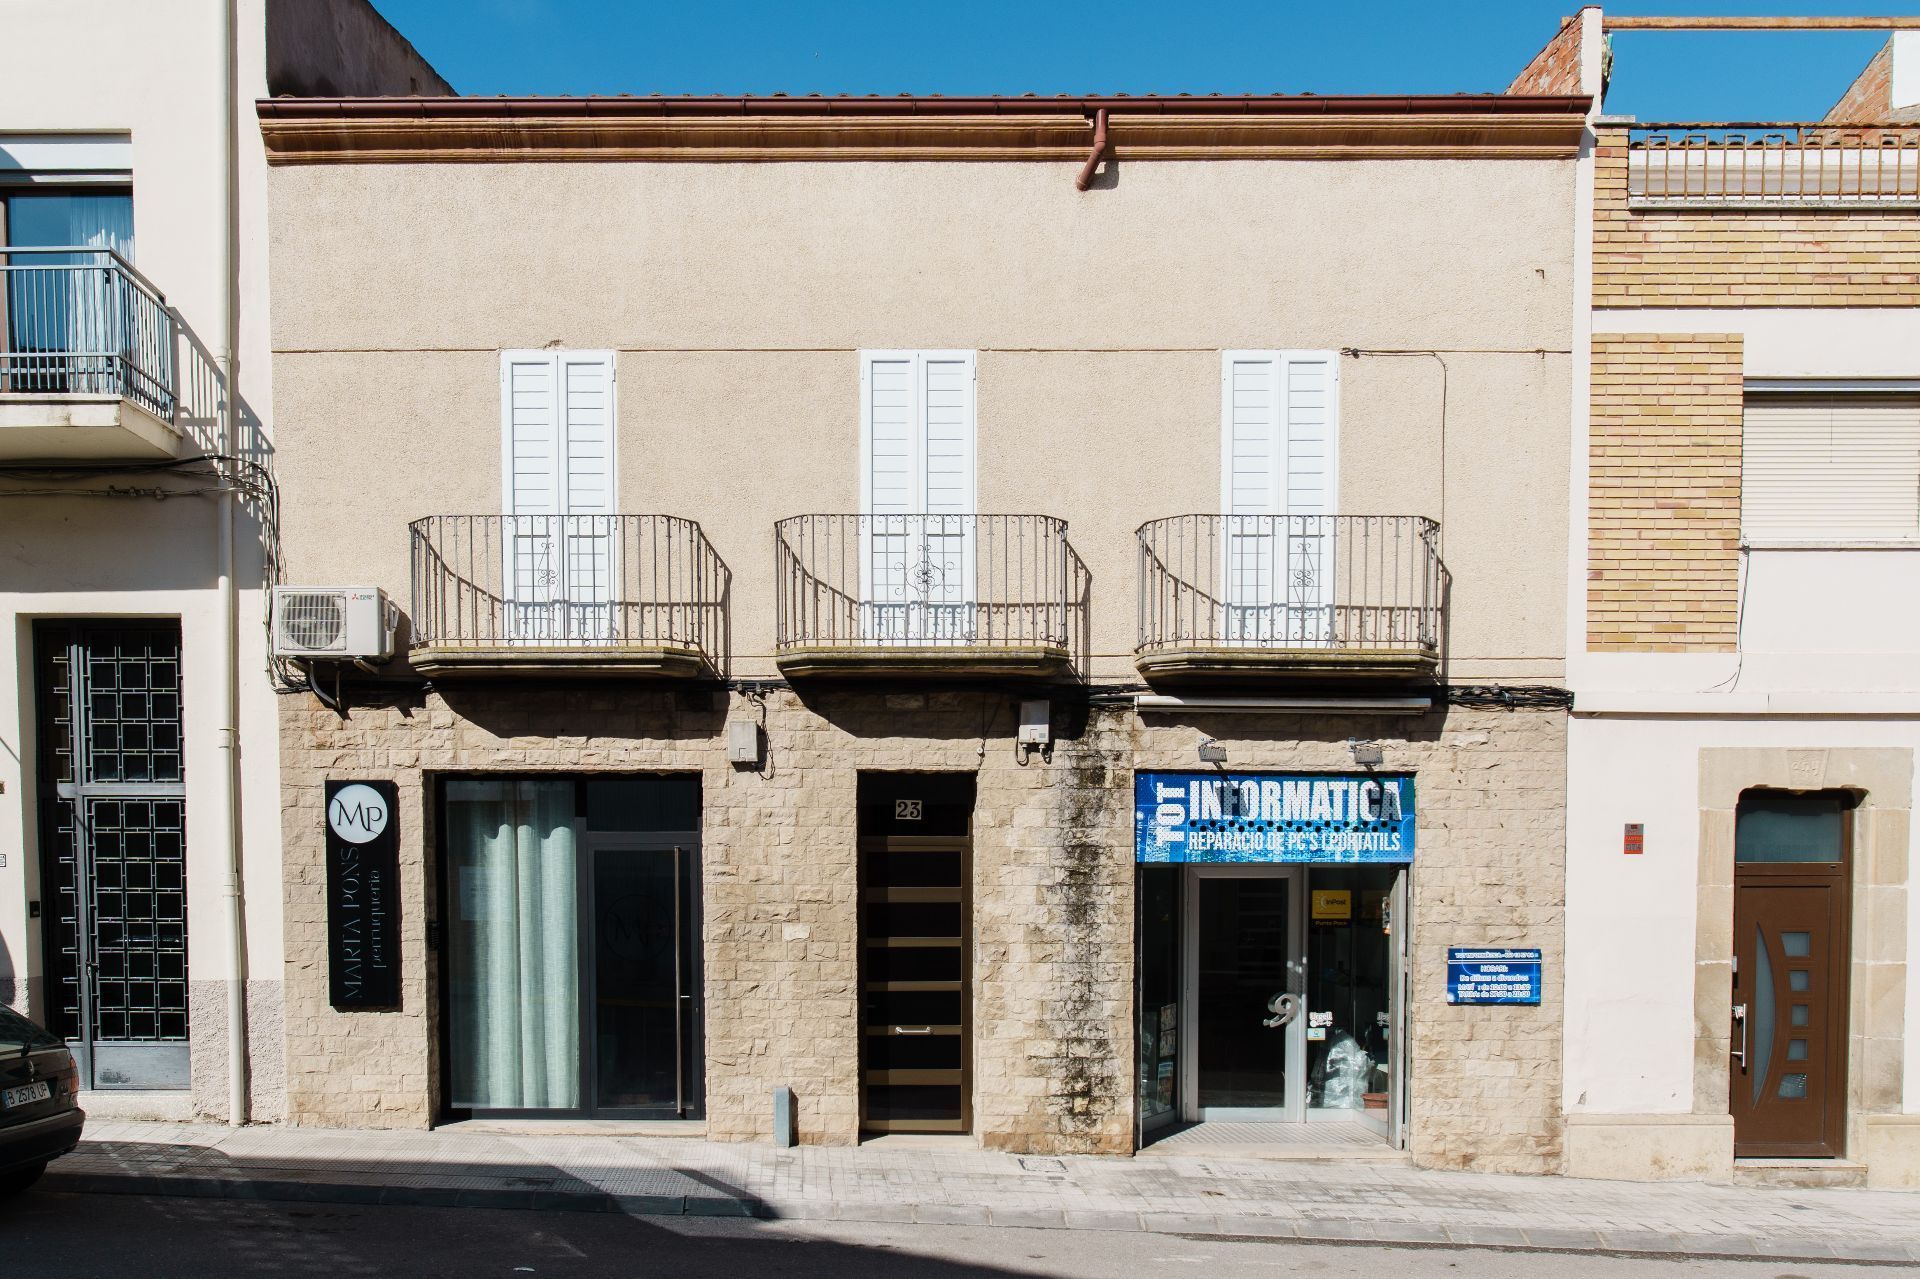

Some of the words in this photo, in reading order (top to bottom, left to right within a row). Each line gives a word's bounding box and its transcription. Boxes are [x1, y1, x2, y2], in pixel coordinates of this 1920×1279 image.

[332, 797, 383, 834] MP
[897, 801, 921, 818] 23
[1156, 783, 1186, 846] TOT
[1190, 781, 1402, 821] INFORMATICA
[1267, 832, 1284, 850] DE
[340, 847, 361, 908] PONS
[343, 919, 362, 999] MARTA
[8, 1092, 15, 1104] B
[16, 1087, 36, 1103] 2578
